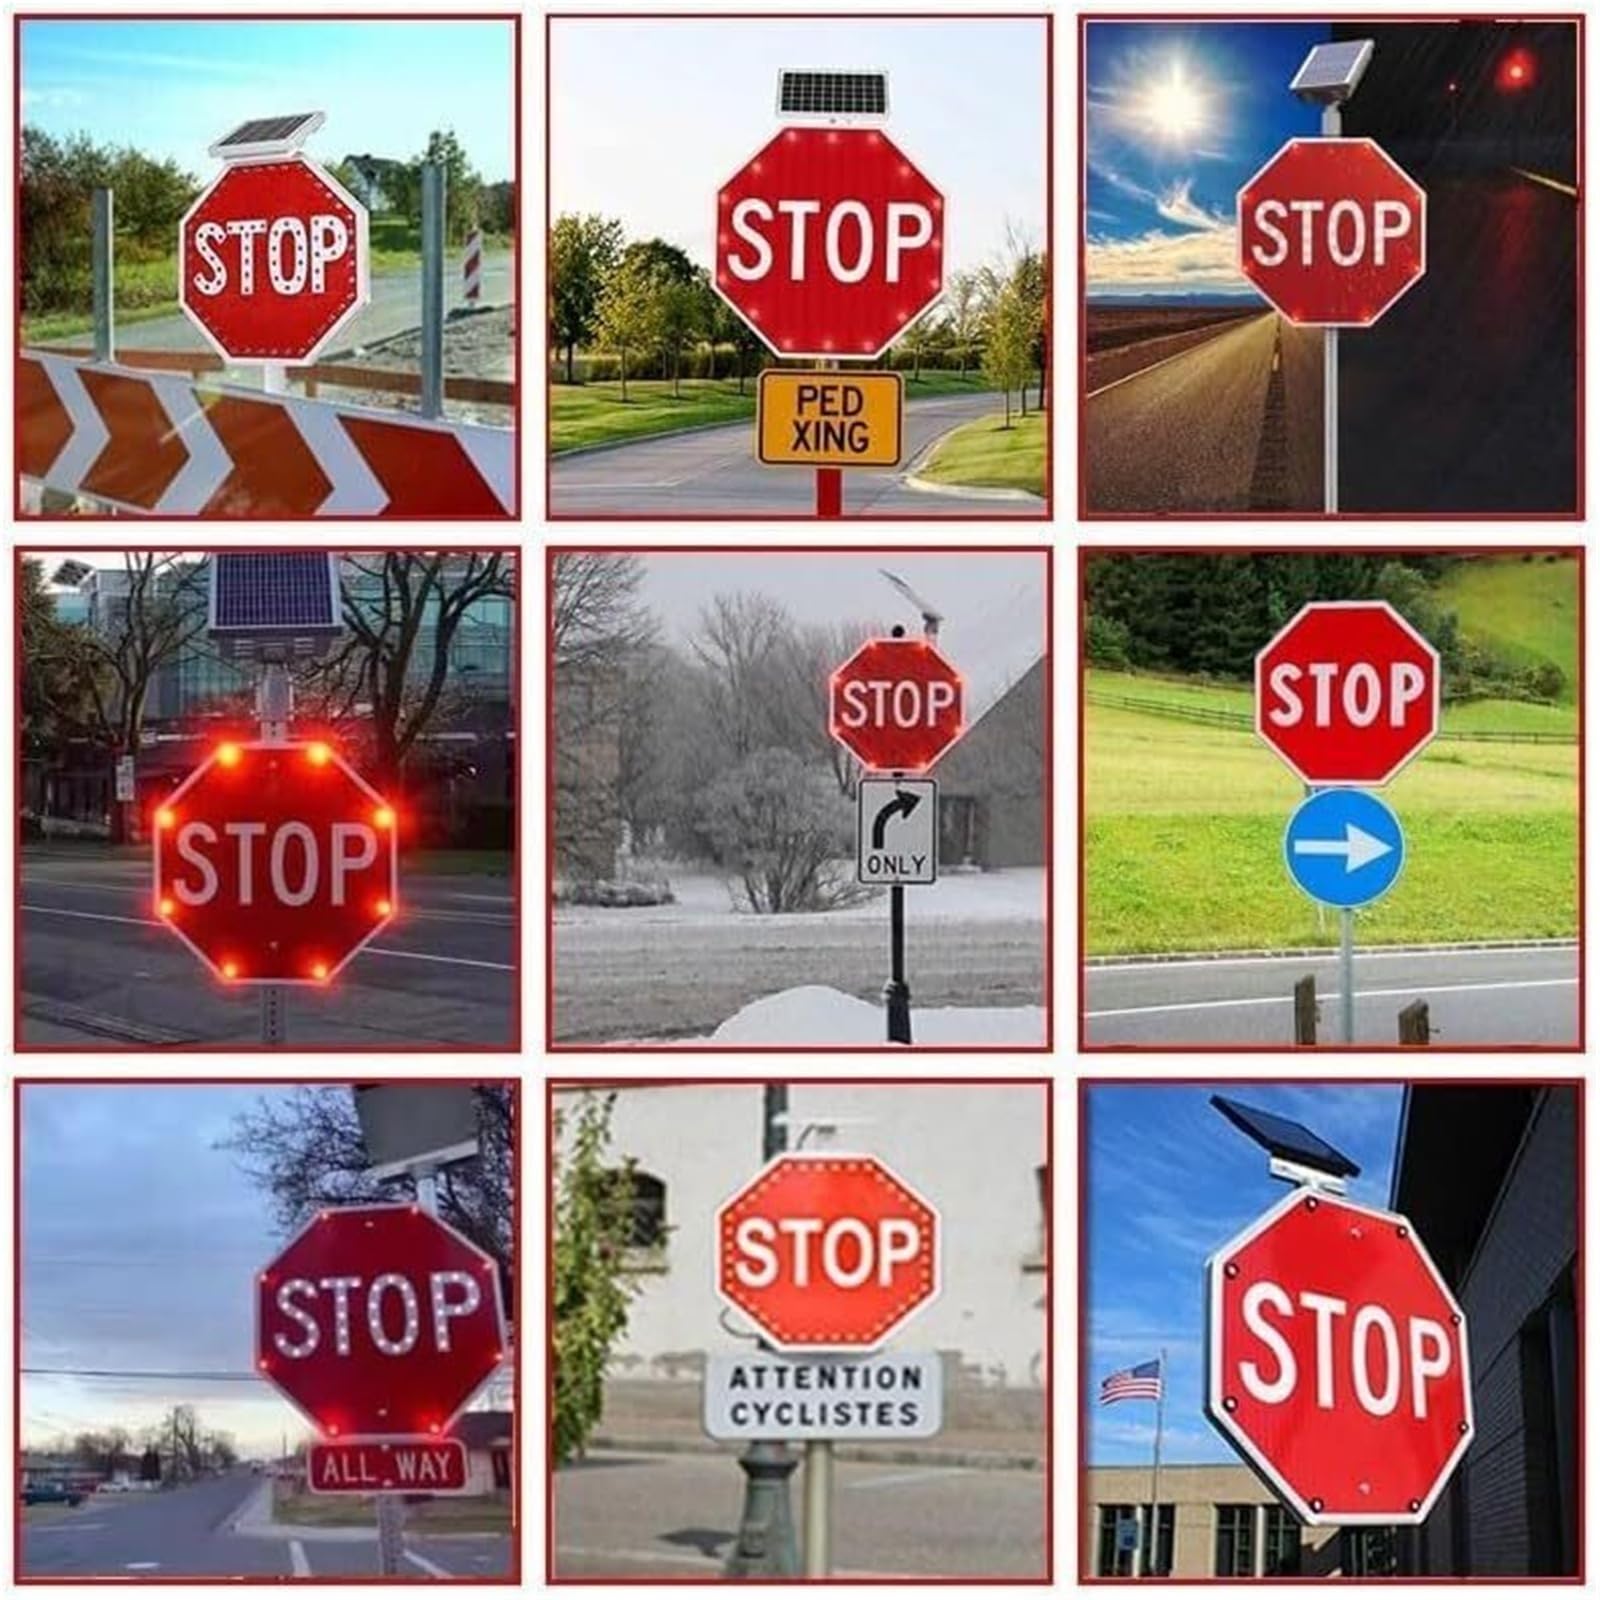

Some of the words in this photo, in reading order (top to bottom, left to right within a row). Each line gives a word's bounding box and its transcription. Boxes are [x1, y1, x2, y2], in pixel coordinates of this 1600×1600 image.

[193, 214, 349, 296] STOP
[727, 198, 934, 284] STOP
[1252, 199, 1412, 267] STOP
[796, 384, 864, 417] PED
[791, 420, 870, 454] XING
[841, 680, 955, 728] STOP
[1269, 662, 1425, 728] STOP
[173, 821, 377, 907] STOP
[866, 854, 928, 876] ONLY
[735, 1217, 920, 1287] STOP
[274, 1270, 482, 1359] STOP
[729, 1364, 922, 1391] ATTENTION
[1238, 1281, 1452, 1419] STOP
[730, 1401, 919, 1427] CYCLISTES
[322, 1453, 377, 1483] ALL
[395, 1450, 452, 1481] WAY
